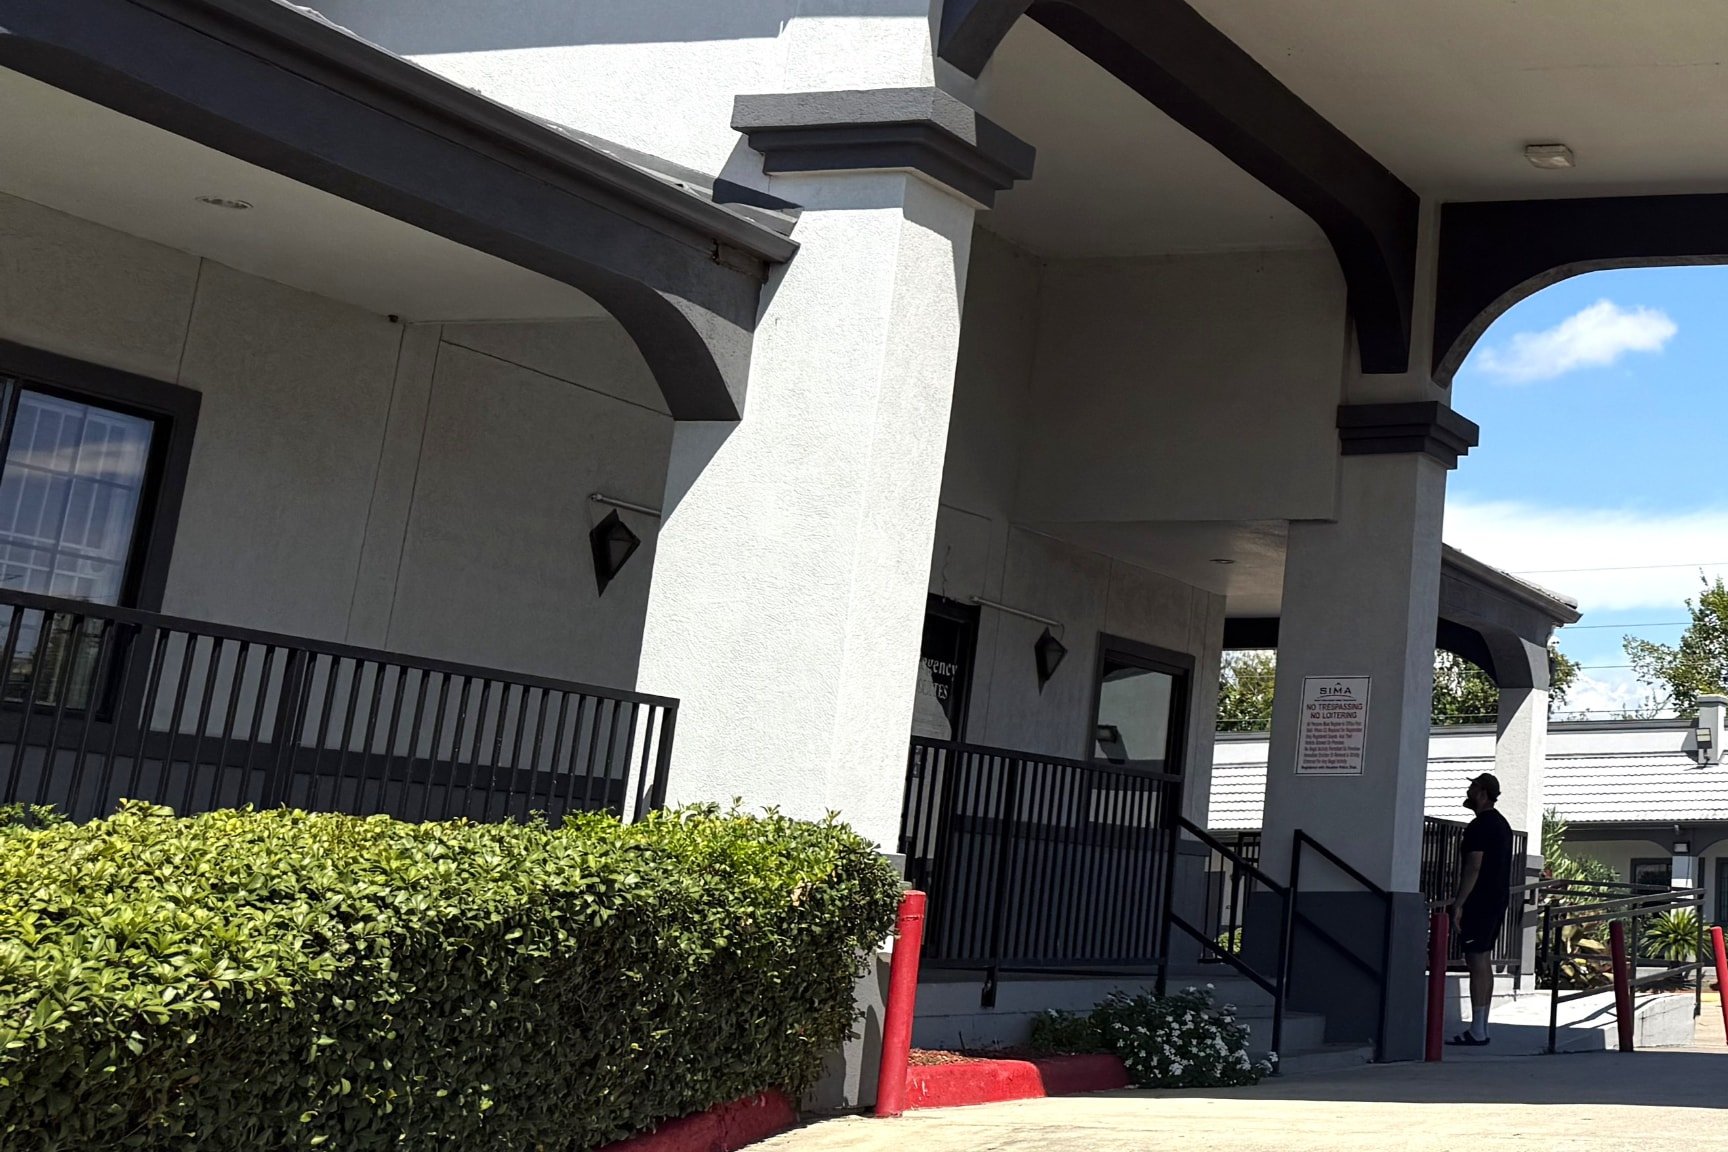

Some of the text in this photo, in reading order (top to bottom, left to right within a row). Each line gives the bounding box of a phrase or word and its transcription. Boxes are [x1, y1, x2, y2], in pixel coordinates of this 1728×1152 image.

[1319, 687, 1352, 695] SIMA
[1306, 703, 1363, 711] NO TRESPASSING
[1310, 711, 1357, 719] NO LOITERING
